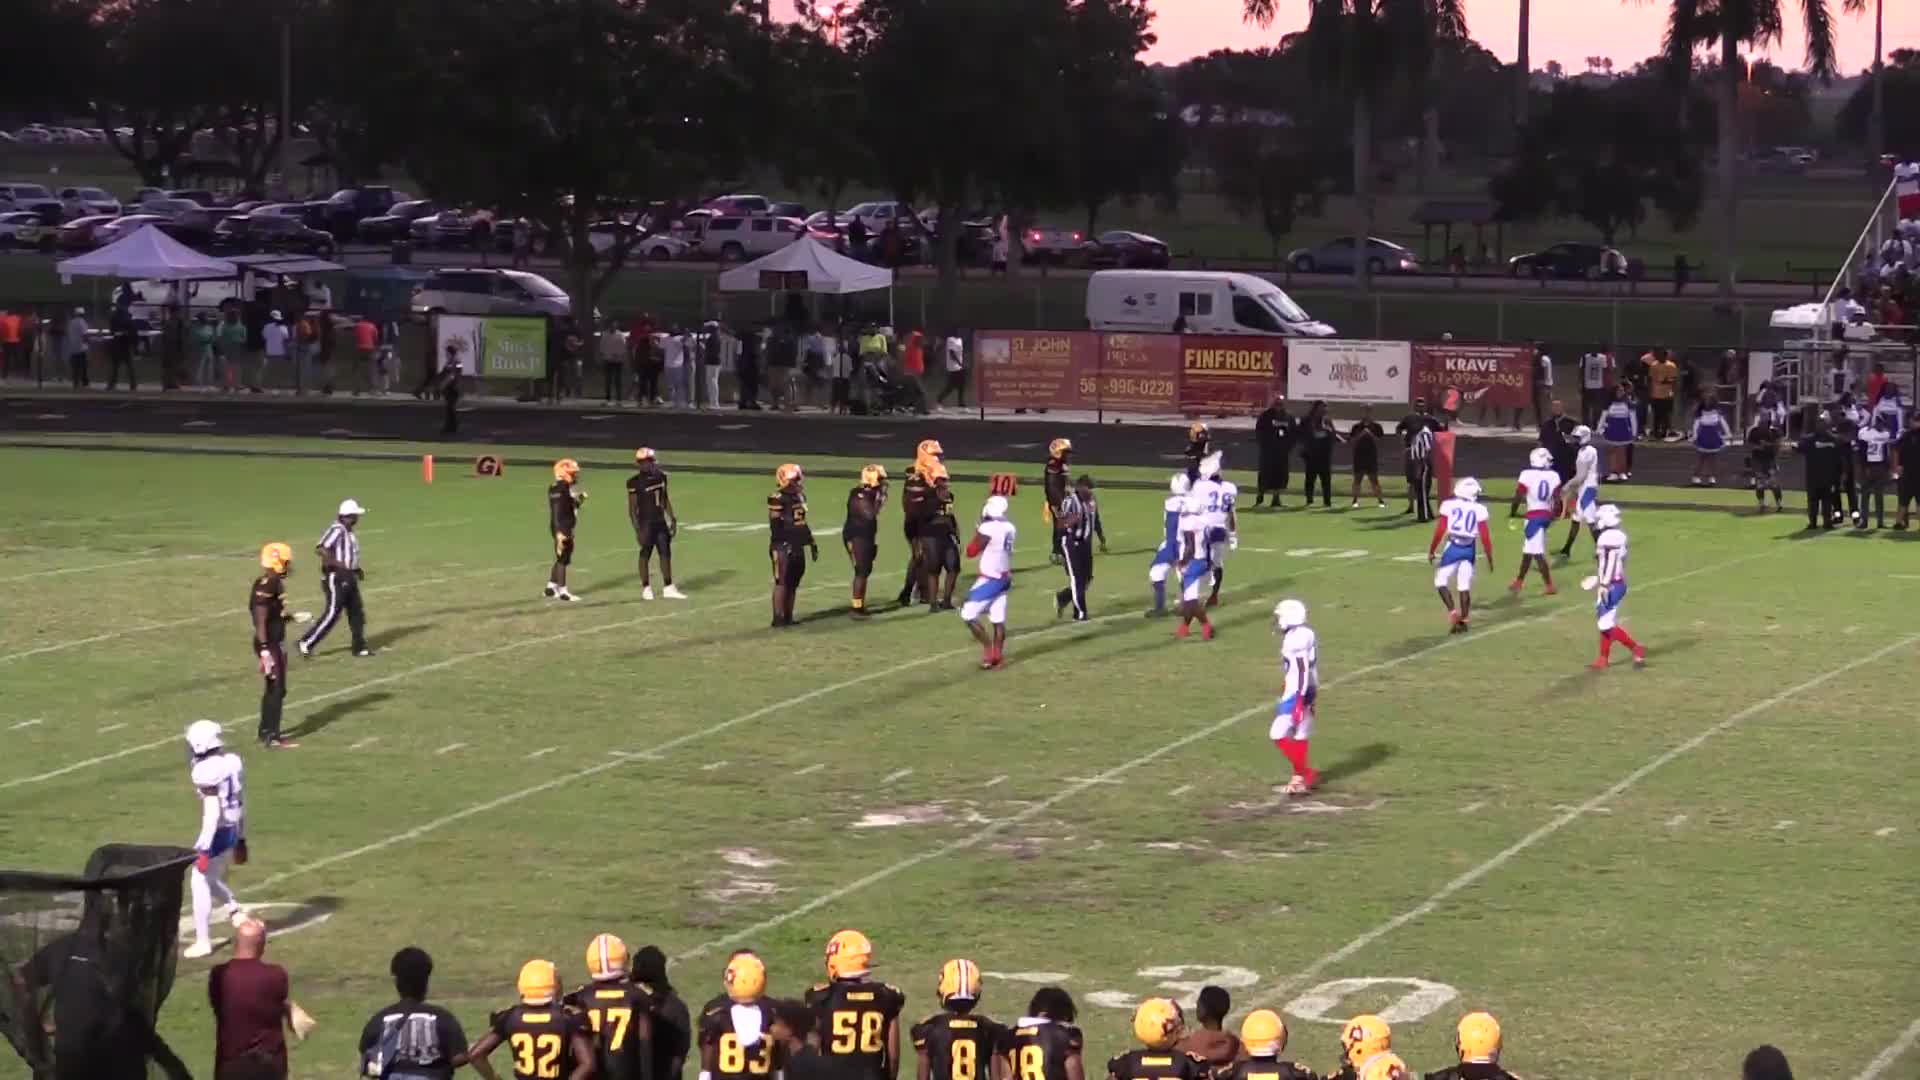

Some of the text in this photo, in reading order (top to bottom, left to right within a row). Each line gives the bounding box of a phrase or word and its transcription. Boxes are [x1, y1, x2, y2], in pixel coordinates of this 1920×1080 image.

[1032, 336, 1071, 352] JOHN
[1184, 349, 1274, 370] FINFROCK
[1446, 358, 1497, 371] KRAVE
[1079, 376, 1174, 396] 56-996-0228
[477, 456, 497, 474] G
[992, 474, 1010, 495] 10
[1537, 480, 1549, 501] 0
[1450, 507, 1477, 532] 20
[588, 1007, 632, 1052] 17
[511, 1033, 562, 1078] 32
[718, 1033, 774, 1074] 83
[951, 1039, 977, 1080] 8
